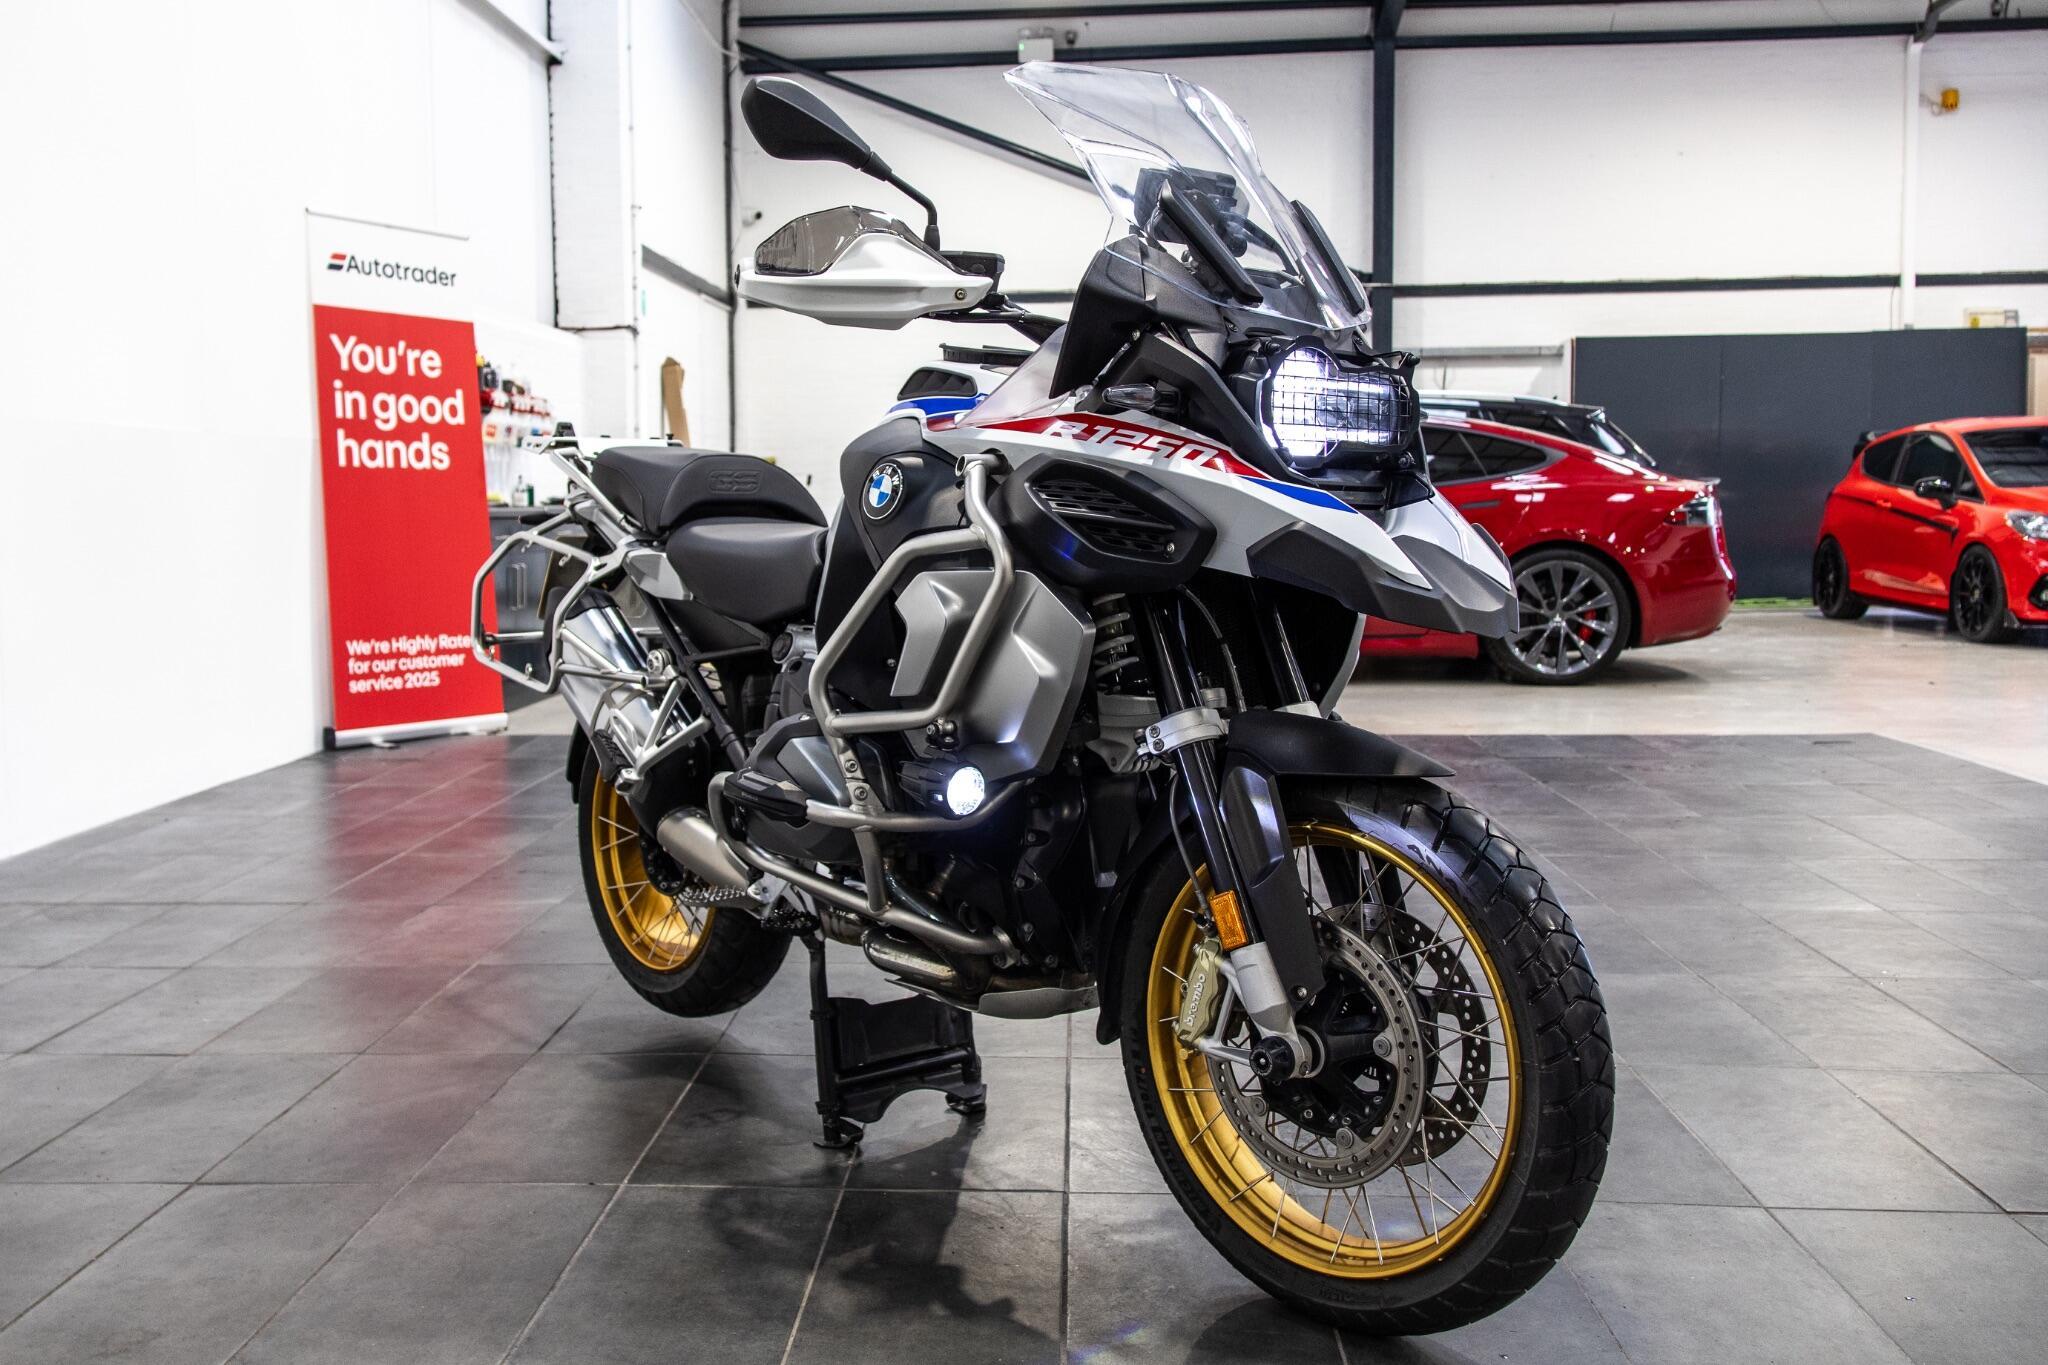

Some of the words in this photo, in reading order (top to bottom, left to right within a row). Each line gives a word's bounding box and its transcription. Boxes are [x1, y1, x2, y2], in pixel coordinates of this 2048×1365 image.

[347, 255, 456, 286] Autotrader
[330, 333, 442, 378] You're
[333, 379, 367, 420] in
[372, 388, 465, 431] good
[337, 428, 450, 470] hands
[346, 639, 390, 656] We're
[392, 635, 437, 656] Highly
[439, 633, 472, 649] Rate
[348, 657, 370, 675] for
[372, 658, 397, 673] our
[398, 653, 465, 671] customer
[349, 675, 404, 694] service
[404, 670, 440, 689] 2025
[1183, 973, 1206, 1027] brembo
